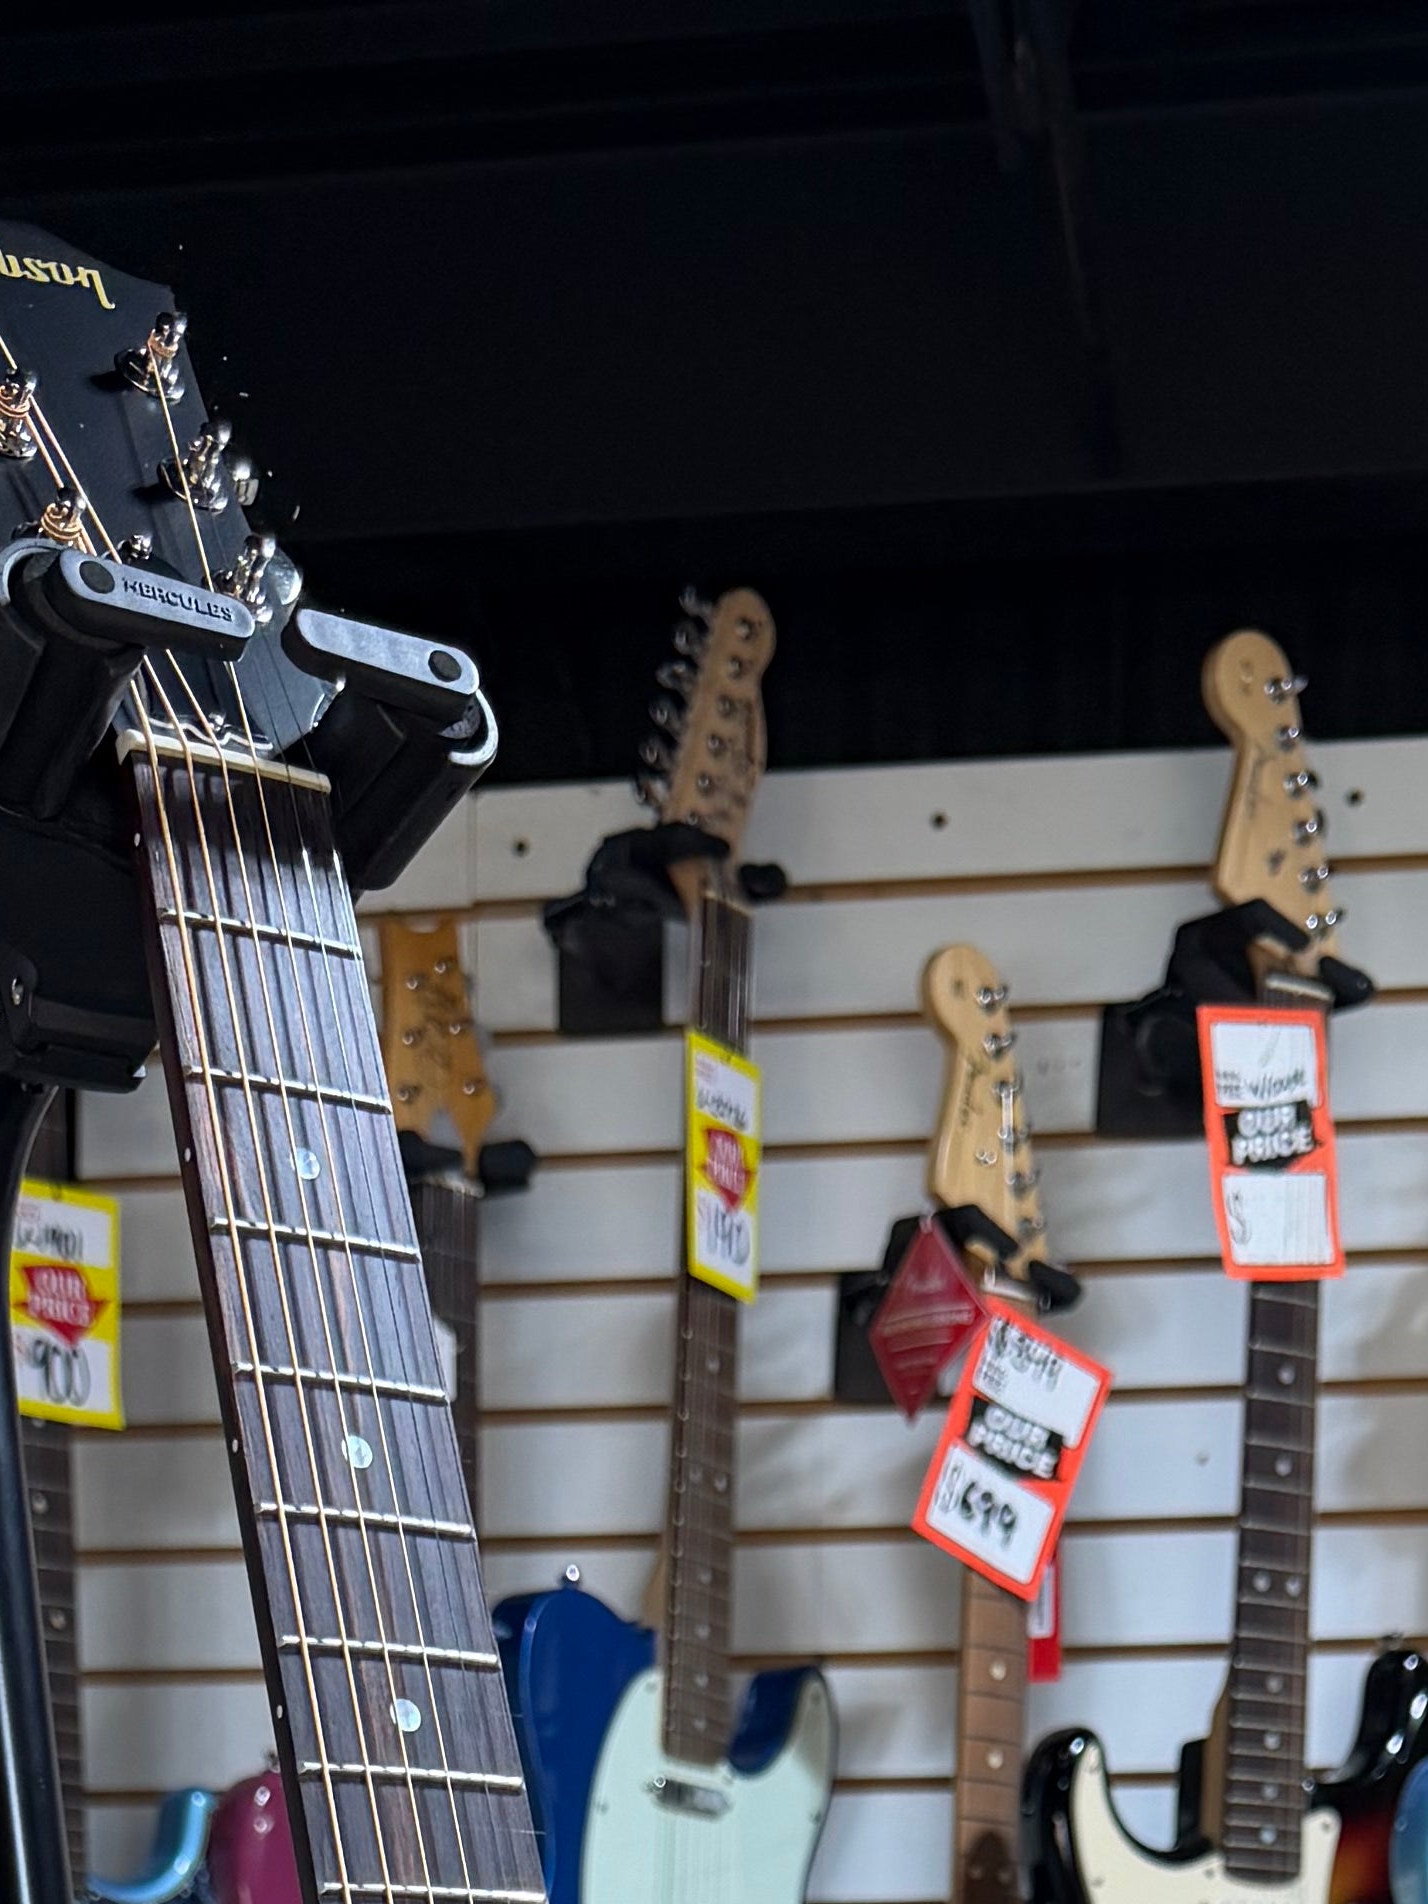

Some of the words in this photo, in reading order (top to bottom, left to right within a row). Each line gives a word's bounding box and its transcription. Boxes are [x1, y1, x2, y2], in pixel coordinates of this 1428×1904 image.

[122, 576, 233, 622] HERCULES
[1232, 1125, 1313, 1166] PRICE
[984, 1404, 1050, 1444] OUR
[968, 1421, 1058, 1479] PRICE
